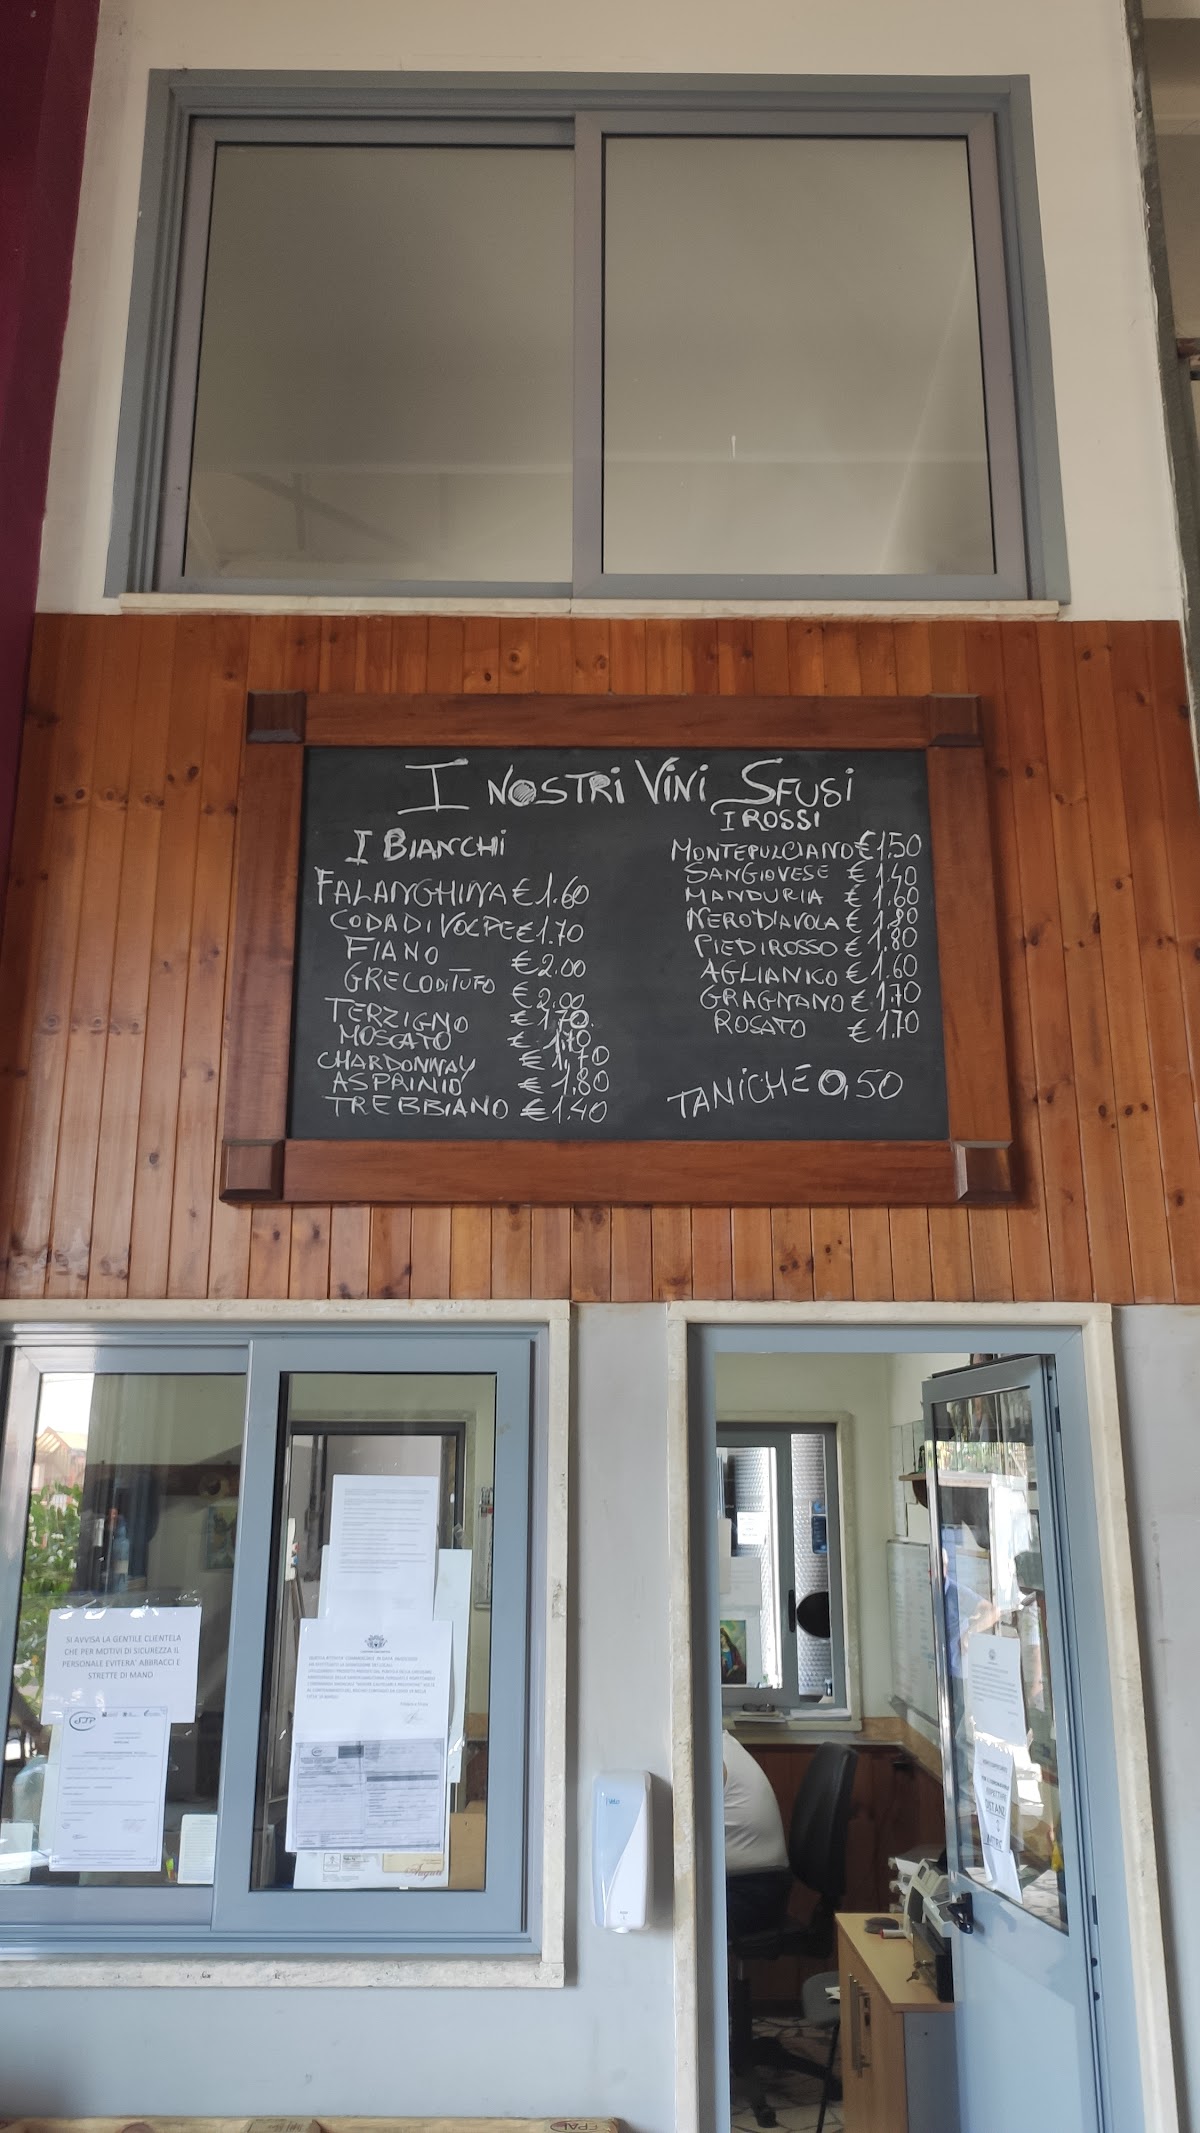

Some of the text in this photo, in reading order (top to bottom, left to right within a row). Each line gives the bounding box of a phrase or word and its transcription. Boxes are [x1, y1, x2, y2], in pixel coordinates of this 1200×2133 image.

[397, 758, 470, 815] I
[742, 809, 821, 832] ROSSI
[345, 829, 373, 866] I
[671, 838, 854, 862] MONTEPULCIANO
[684, 862, 829, 885] SANGIOVESE
[314, 866, 507, 908] FALANGHINA
[685, 886, 824, 905] MANDURIA
[344, 934, 439, 965] FIANO
[700, 958, 838, 986] AGLIANICO
[700, 984, 844, 1012] GRAGNANO
[324, 997, 468, 1033] TERZIGNO
[714, 1009, 806, 1039] ROSATO
[339, 1023, 451, 1051] MOSCATO
[324, 1095, 509, 1119] TREBBIANO
[64, 1648, 78, 1656] CHE
[95, 1647, 122, 1655] MOTIVI
[124, 1647, 132, 1655] DI
[133, 1646, 172, 1654] SICUREZZA
[112, 1635, 142, 1643] GENTILE
[144, 1634, 182, 1642] CLIENTELA
[62, 1660, 104, 1668] PERSONALE
[139, 1658, 175, 1666] ABBRACCI
[88, 1672, 118, 1680] STRETTE
[120, 1671, 128, 1679] DI
